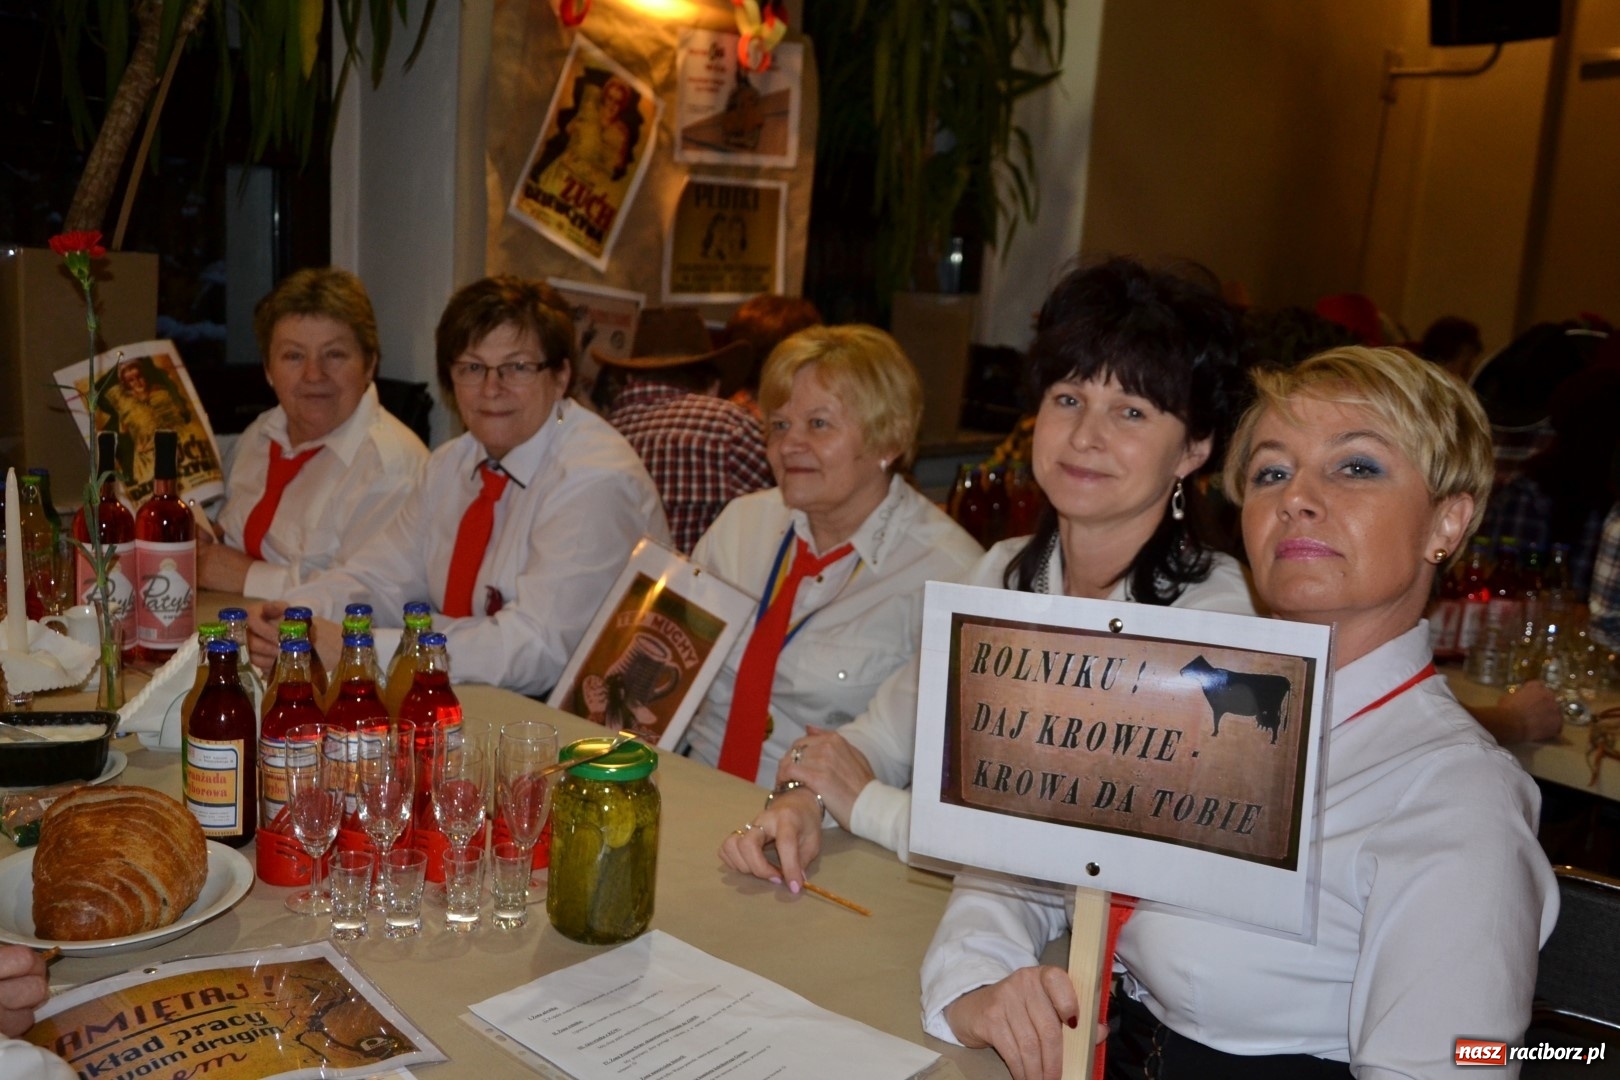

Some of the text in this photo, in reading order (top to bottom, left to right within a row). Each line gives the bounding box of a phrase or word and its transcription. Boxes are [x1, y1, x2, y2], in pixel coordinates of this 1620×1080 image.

[652, 616, 697, 663] MUCHY
[970, 642, 1148, 694] ROLNIKU !
[971, 703, 1029, 740] DAJ
[1036, 714, 1183, 763] KROWIE
[972, 759, 1263, 836] KROWA DA TOBIE
[50, 975, 277, 1057] AMIĘTAJ !
[170, 1010, 270, 1045] pracy
[192, 1024, 285, 1054] drugim
